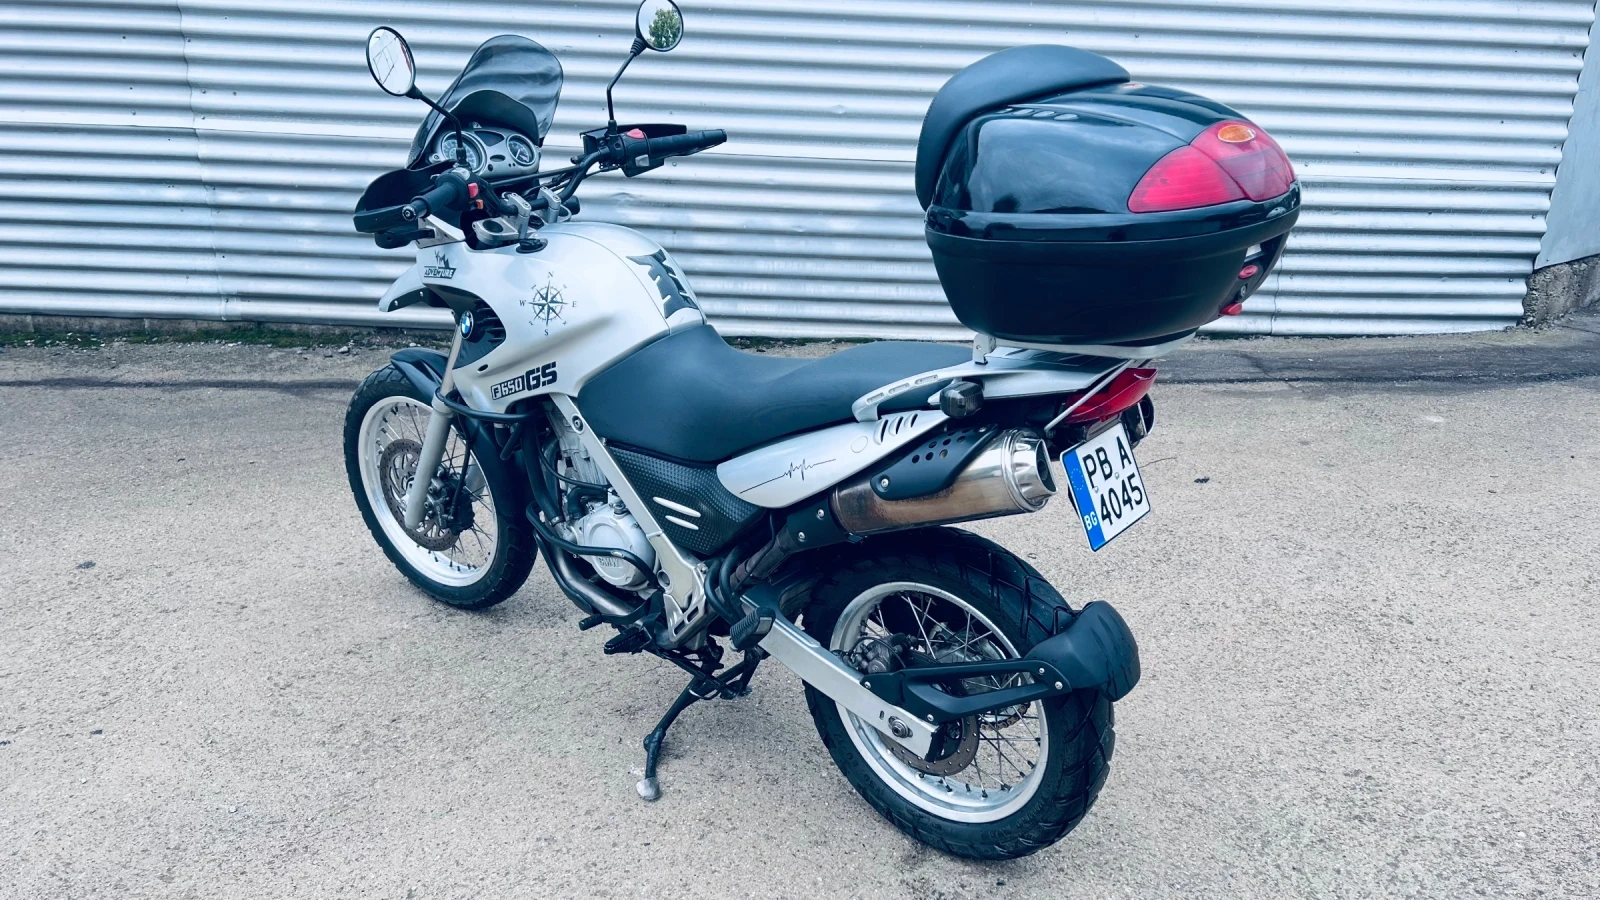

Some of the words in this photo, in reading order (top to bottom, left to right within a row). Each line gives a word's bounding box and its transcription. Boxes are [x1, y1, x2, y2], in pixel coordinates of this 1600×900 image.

[424, 267, 454, 278] ADVENTURE
[1082, 446, 1113, 489] PB
[1116, 435, 1132, 470] A
[1100, 472, 1143, 526] 4045
[1084, 511, 1098, 531] BG
